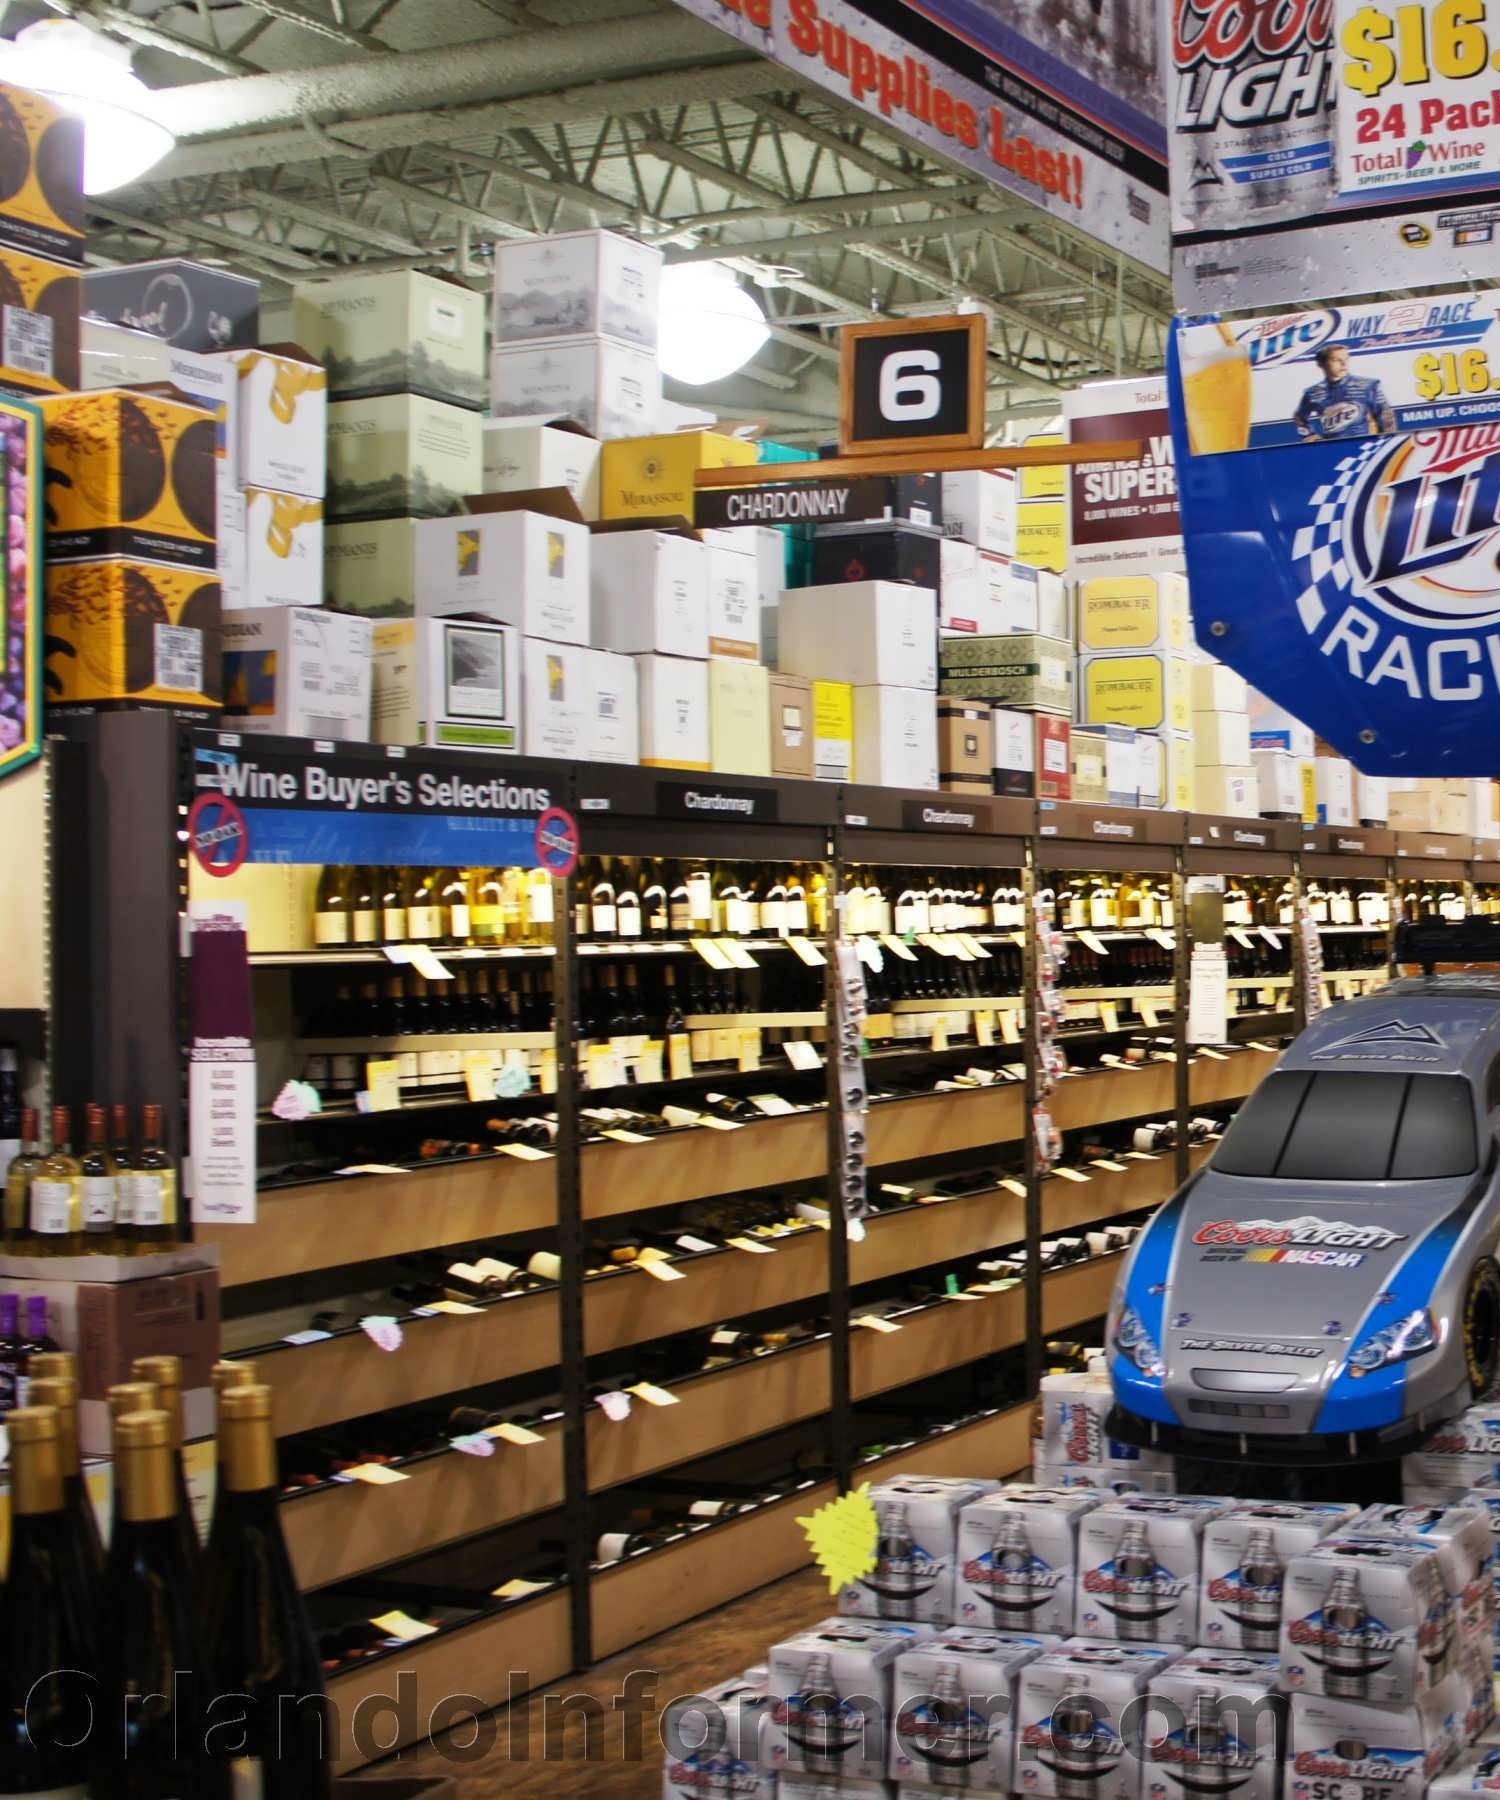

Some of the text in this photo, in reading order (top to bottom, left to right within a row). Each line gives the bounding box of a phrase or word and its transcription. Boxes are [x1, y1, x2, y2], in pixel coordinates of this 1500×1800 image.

[788, 0, 1084, 210] Supplies Last!
[1356, 103, 1406, 144] 24
[1267, 151, 1296, 162] COLD
[1350, 148, 1402, 174] Total
[1427, 141, 1487, 163] Wine
[1449, 160, 1482, 173] MORE
[1250, 162, 1313, 181] SUPER COLD
[1346, 313, 1385, 339] WAY
[1384, 302, 1430, 333] 2
[1428, 302, 1476, 326] RACE
[1249, 318, 1323, 364] Lite
[878, 349, 942, 423] 6
[1134, 390, 1162, 404] Total
[1402, 410, 1429, 423] MAN
[1430, 407, 1458, 420] UP.
[1083, 465, 1178, 504] SUPER
[727, 488, 849, 521] CHARDONNAY
[1075, 552, 1113, 565] Incredible
[1113, 549, 1149, 561] Selection
[947, 665, 1028, 679] MULDERBOSCH
[218, 762, 551, 812] Wine Buyer's Selections
[684, 790, 756, 815] Chardonnay
[921, 807, 977, 828] Chardonnay
[1092, 819, 1136, 838] Chardonnay
[1191, 1219, 1410, 1250] Coors LIGHT
[1278, 1249, 1368, 1269] NASCAR
[1180, 1338, 1325, 1358] THE SILVER BULLET
[1346, 1762, 1414, 1783] LIGHT
